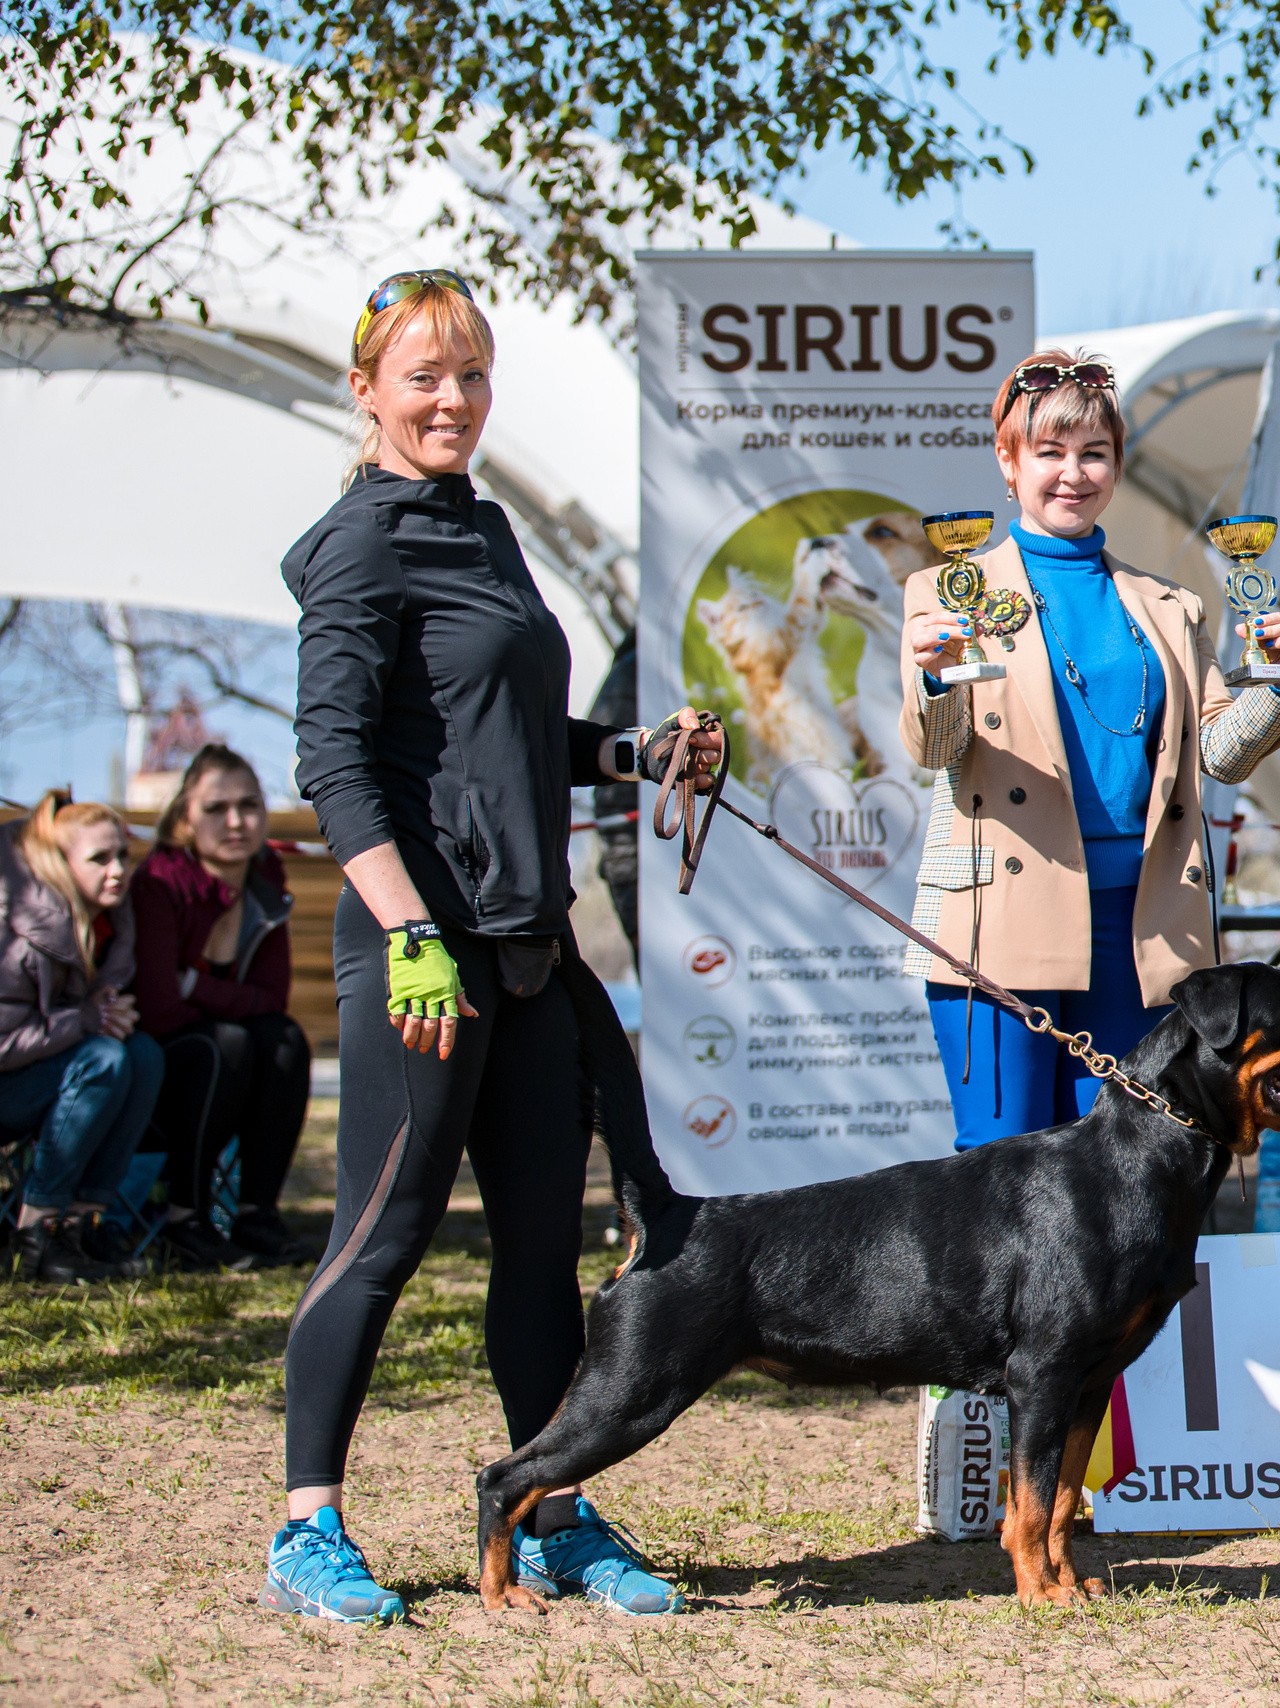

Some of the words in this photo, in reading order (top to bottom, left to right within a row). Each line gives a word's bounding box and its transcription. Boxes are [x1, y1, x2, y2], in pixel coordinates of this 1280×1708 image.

[677, 402, 763, 423] Корма
[741, 431, 792, 450] для
[800, 430, 886, 448] кошек
[895, 432, 910, 448] и
[811, 808, 887, 847] SIRIUS
[749, 945, 842, 961] Высокое
[749, 966, 831, 981] мясных
[837, 965, 908, 982] ингре
[748, 1012, 853, 1028] Комплекс
[860, 1007, 933, 1027] проби
[747, 1034, 788, 1052] для
[793, 1031, 916, 1050] поддержки
[748, 1052, 862, 1072] иммунной
[749, 1103, 763, 1118] В
[768, 1102, 852, 1118] составе
[748, 1124, 820, 1141] овощи
[826, 1123, 839, 1137] и
[847, 1121, 910, 1139] ягоды
[960, 1400, 991, 1524] SIRIUS
